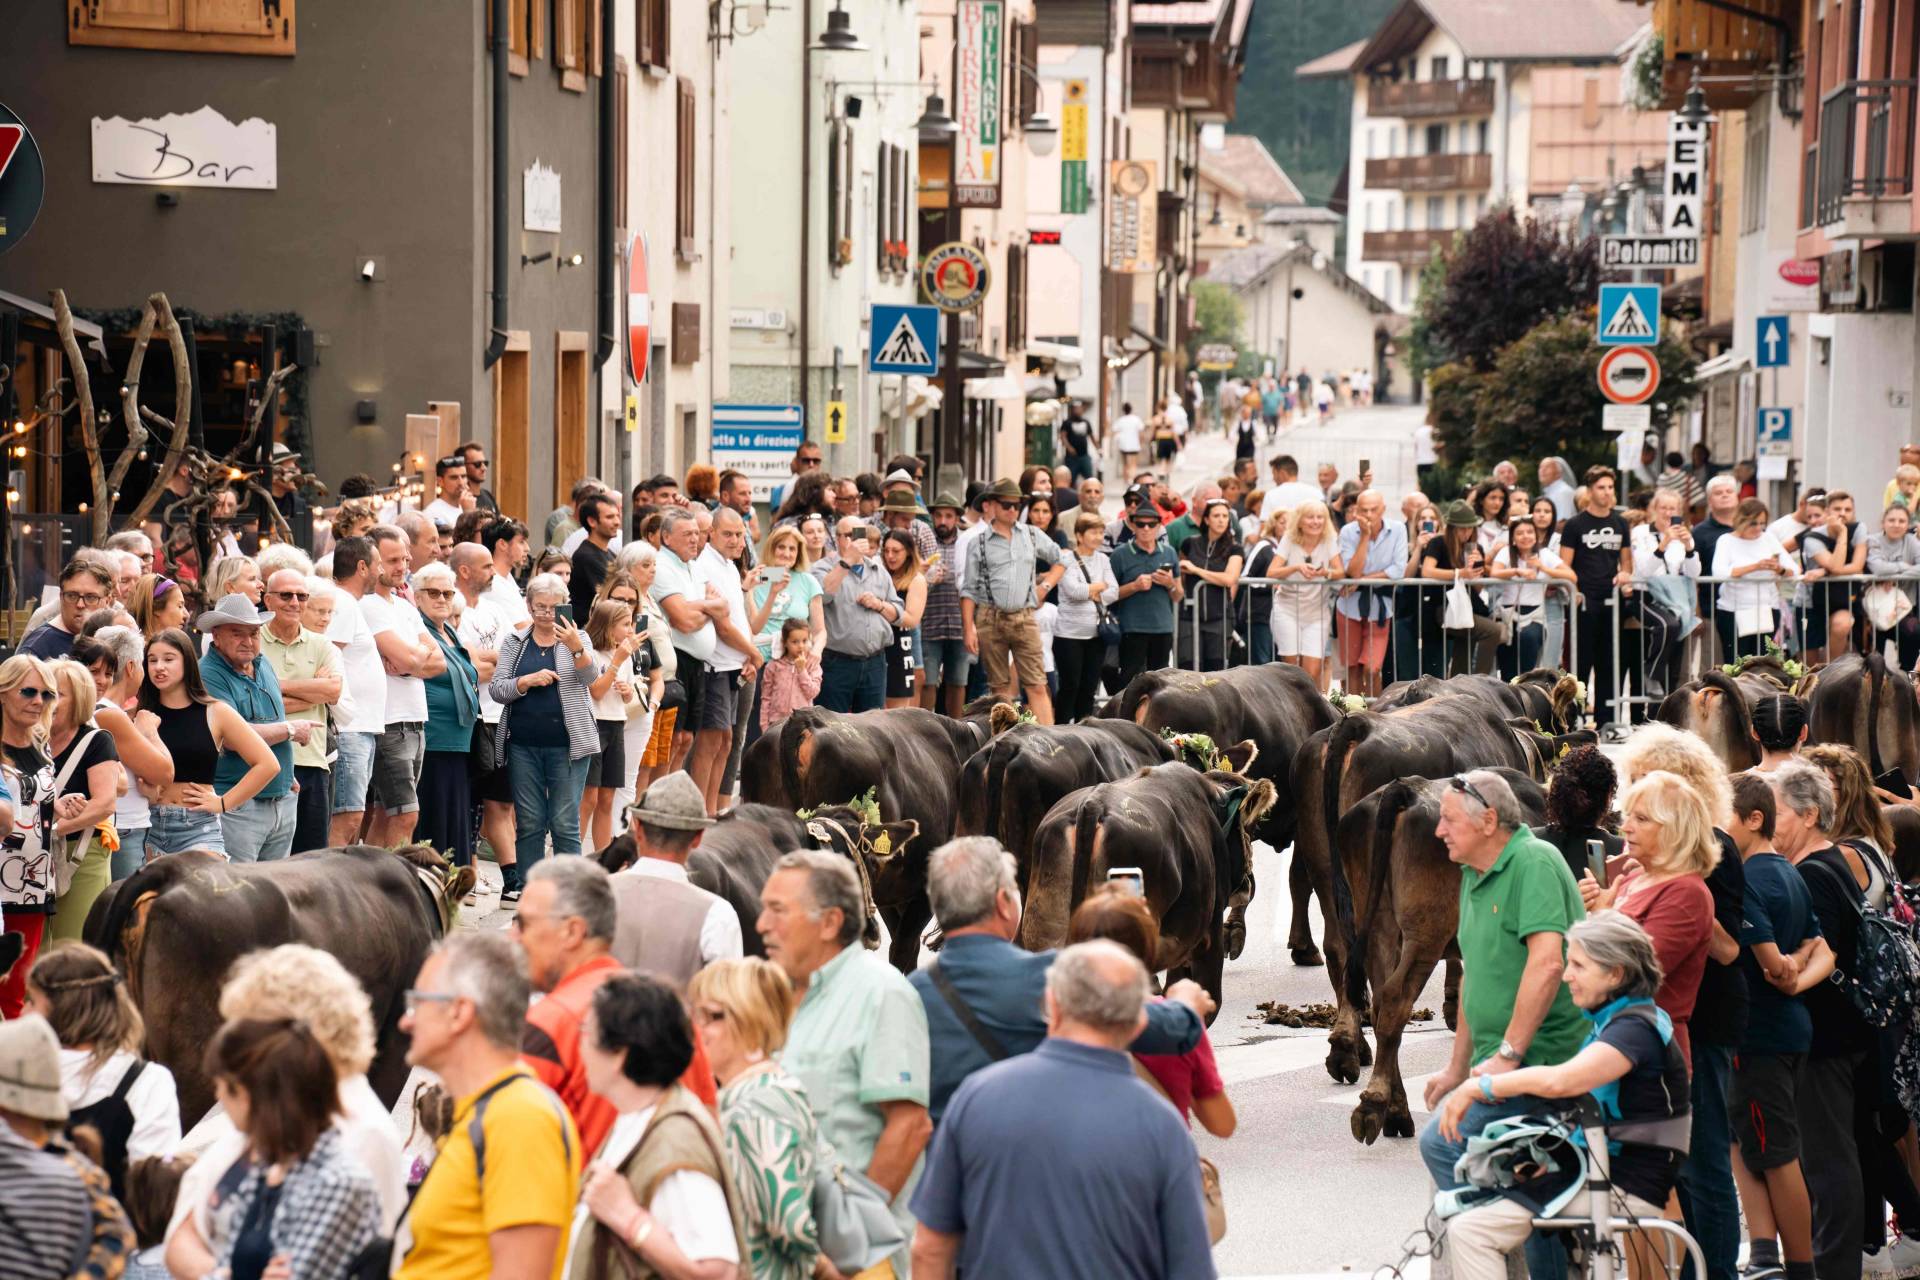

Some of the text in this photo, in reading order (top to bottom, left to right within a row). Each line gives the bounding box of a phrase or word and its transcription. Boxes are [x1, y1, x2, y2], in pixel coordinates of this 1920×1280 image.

[960, 0, 981, 179] BIRRERIA
[983, 11, 998, 139] BILIARDI
[115, 119, 255, 183] Bar
[957, 187, 997, 204] PUB
[1606, 239, 1696, 264] Dolomiti
[738, 433, 751, 447] le
[753, 433, 800, 447] direzioni
[1762, 411, 1785, 440] P
